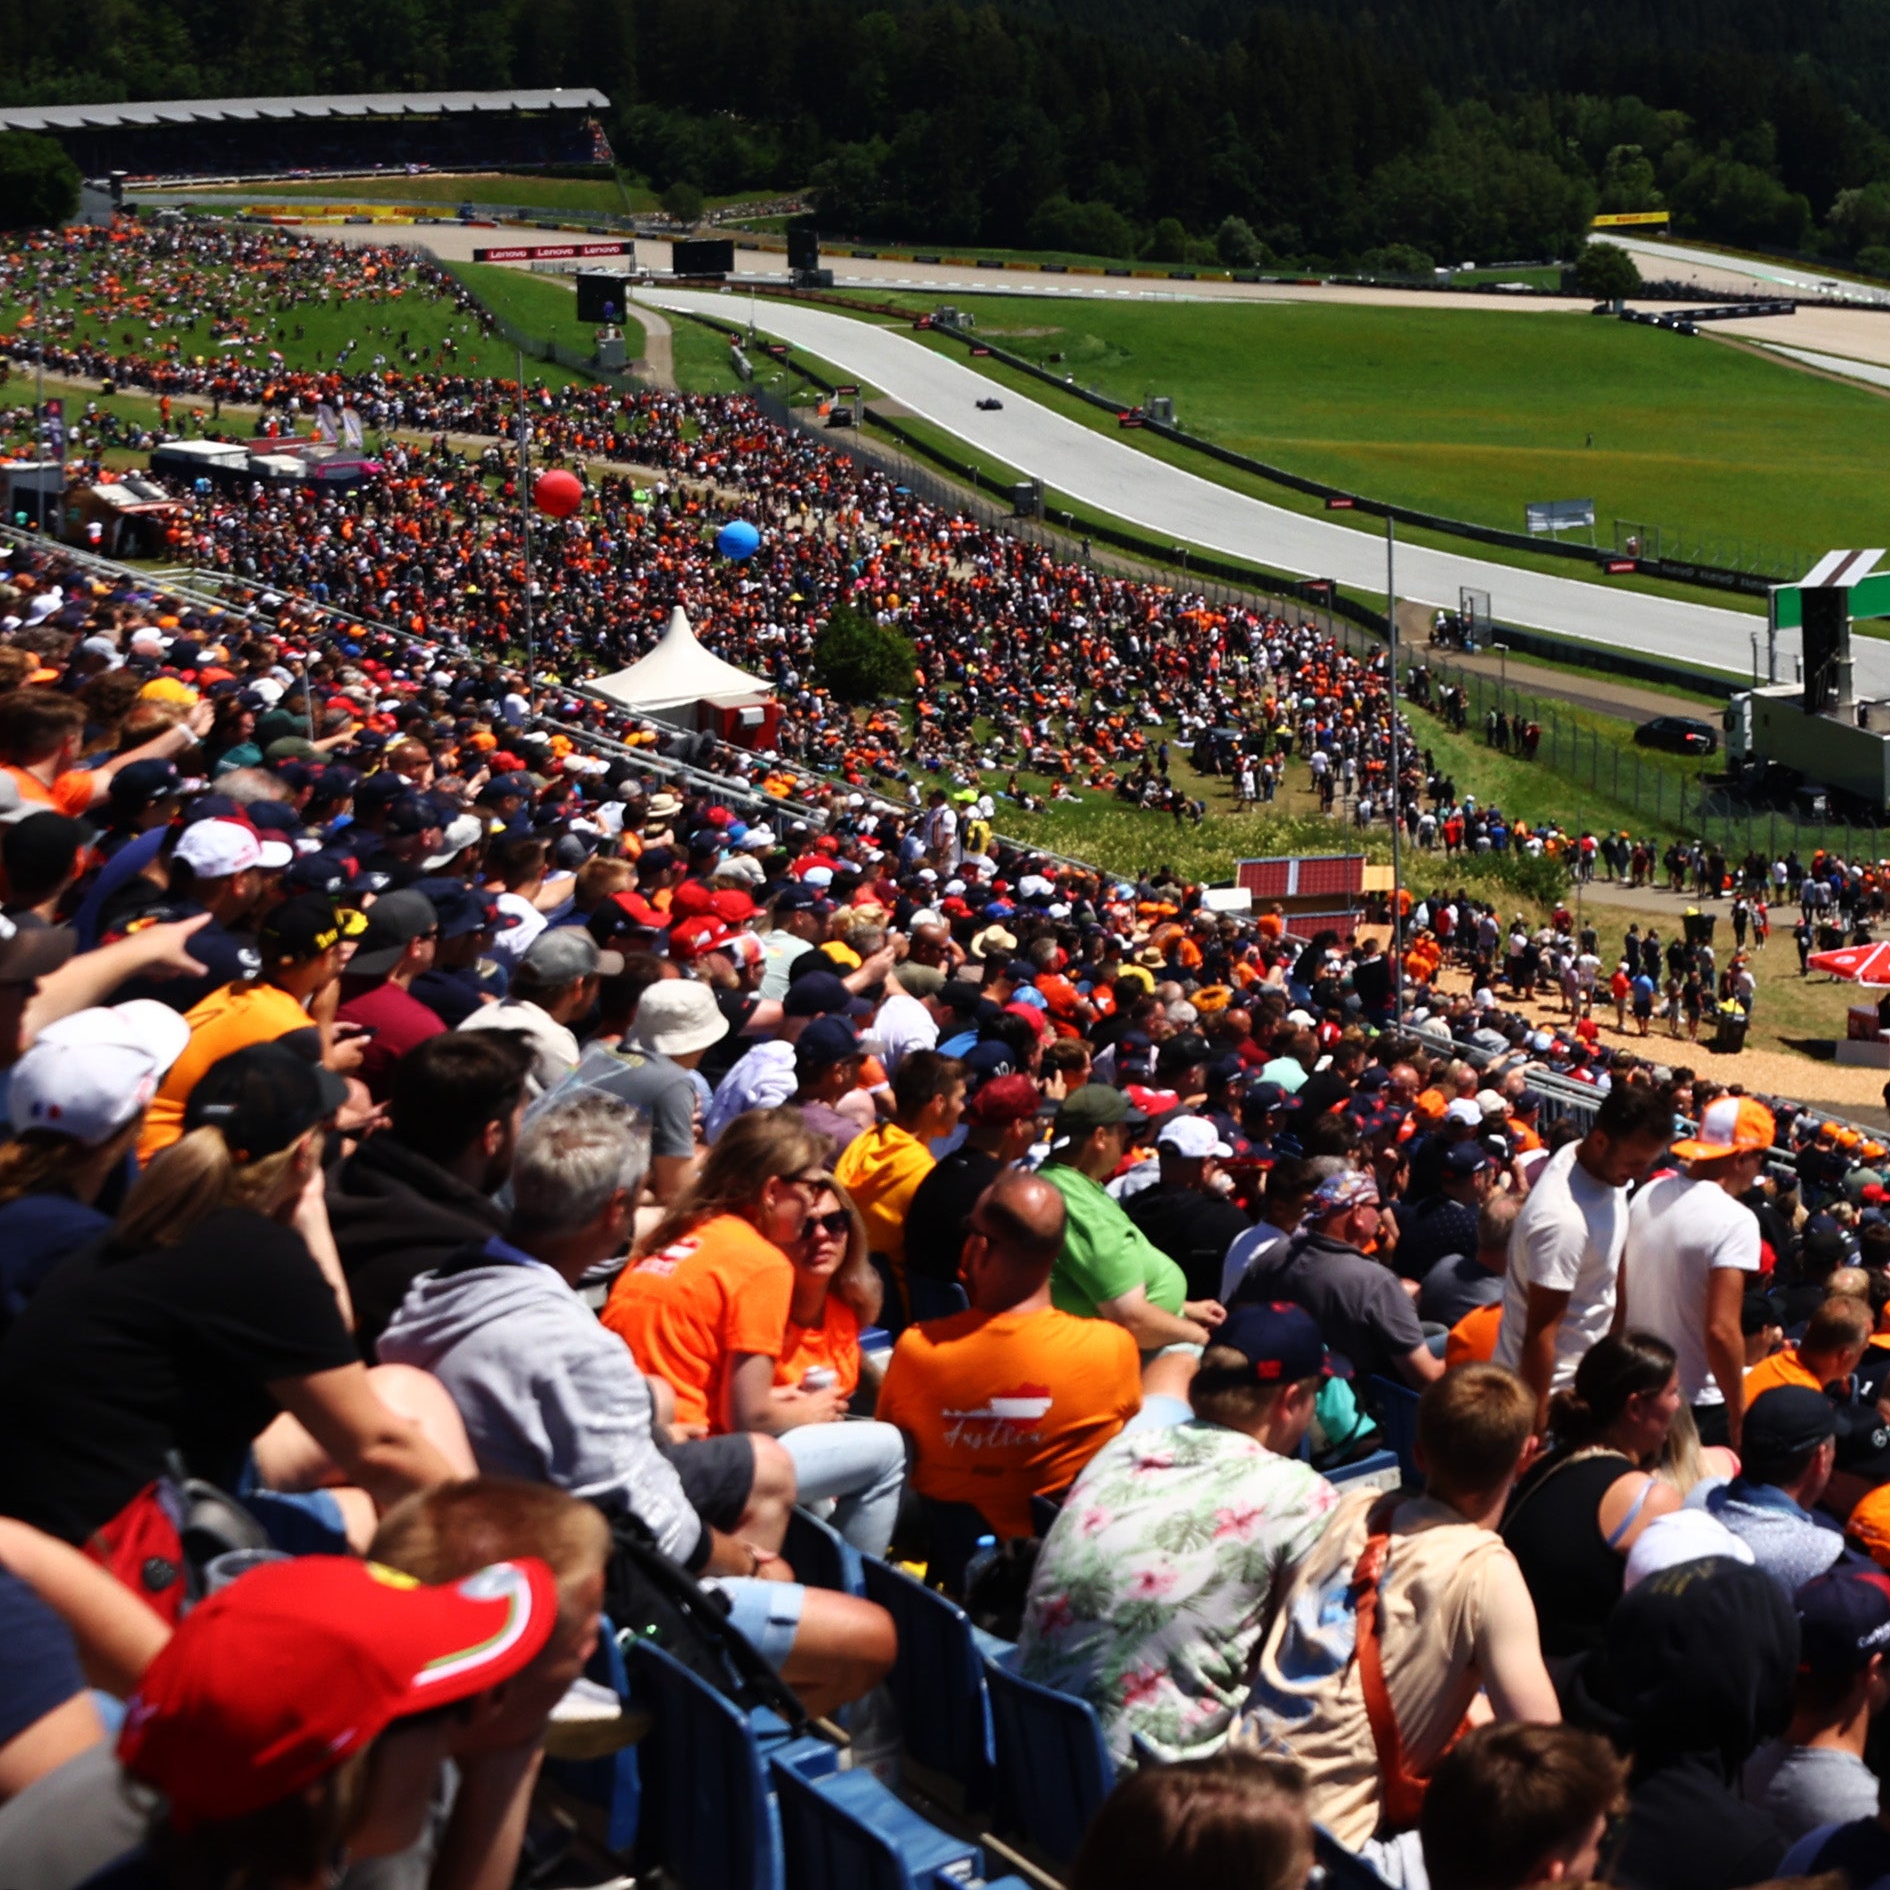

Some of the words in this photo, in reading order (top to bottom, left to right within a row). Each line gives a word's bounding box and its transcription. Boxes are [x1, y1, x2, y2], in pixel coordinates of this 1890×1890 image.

[490, 247, 527, 260] Lenovo
[536, 245, 574, 258] Lenovo
[584, 243, 620, 256] Lenovo
